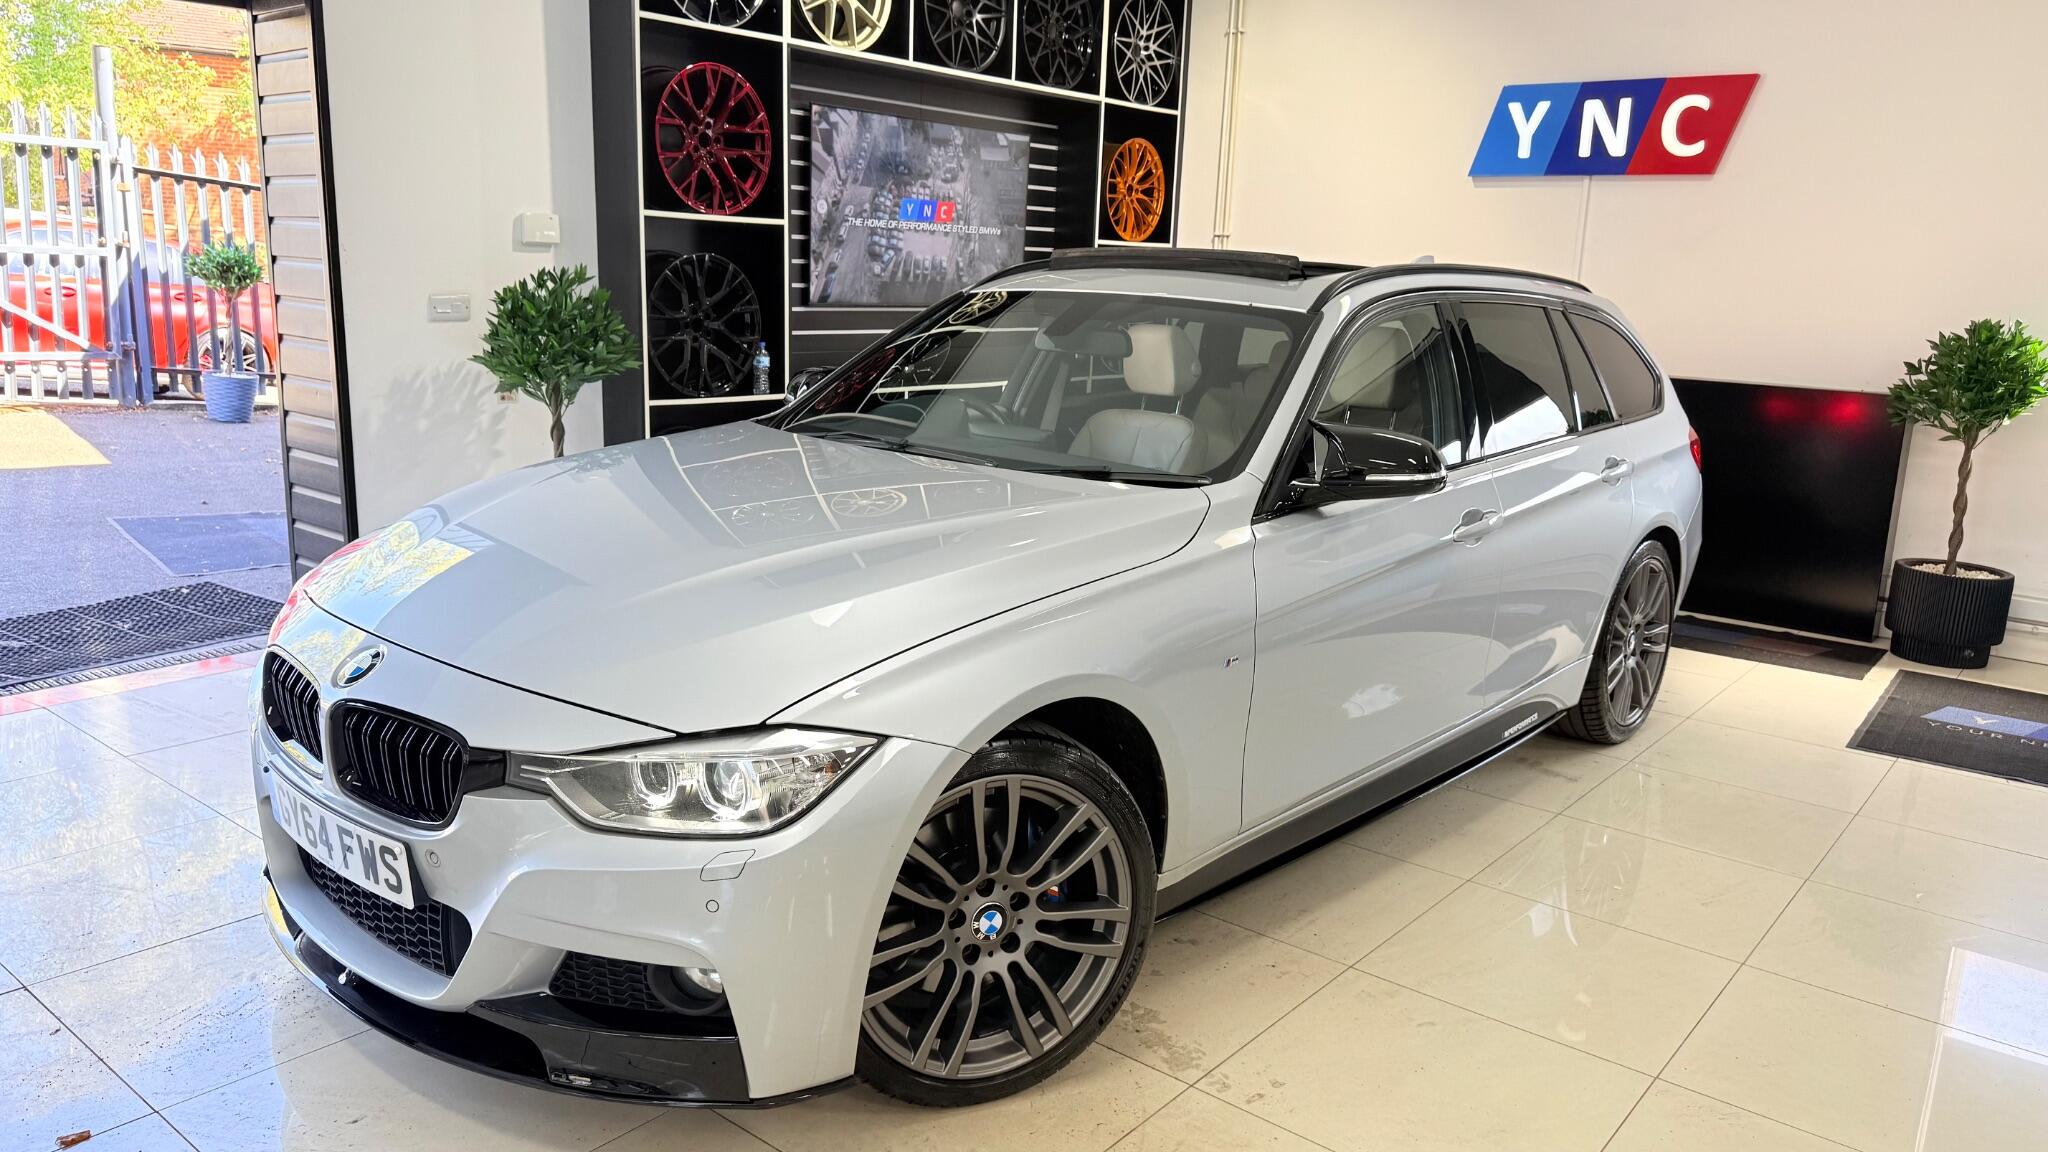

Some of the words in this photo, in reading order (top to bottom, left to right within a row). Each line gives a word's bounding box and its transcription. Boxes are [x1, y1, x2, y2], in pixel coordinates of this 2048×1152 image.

[1507, 94, 1711, 159] YNC
[906, 203, 948, 219] YNC
[847, 217, 864, 227] THE
[864, 218, 887, 228] HOME
[887, 219, 898, 229] OF
[898, 221, 952, 232] PERFORMANCE
[952, 224, 978, 234] STYLED
[1927, 721, 2003, 739] YOUR
[277, 781, 334, 861] GY64
[336, 823, 403, 895] FWS
